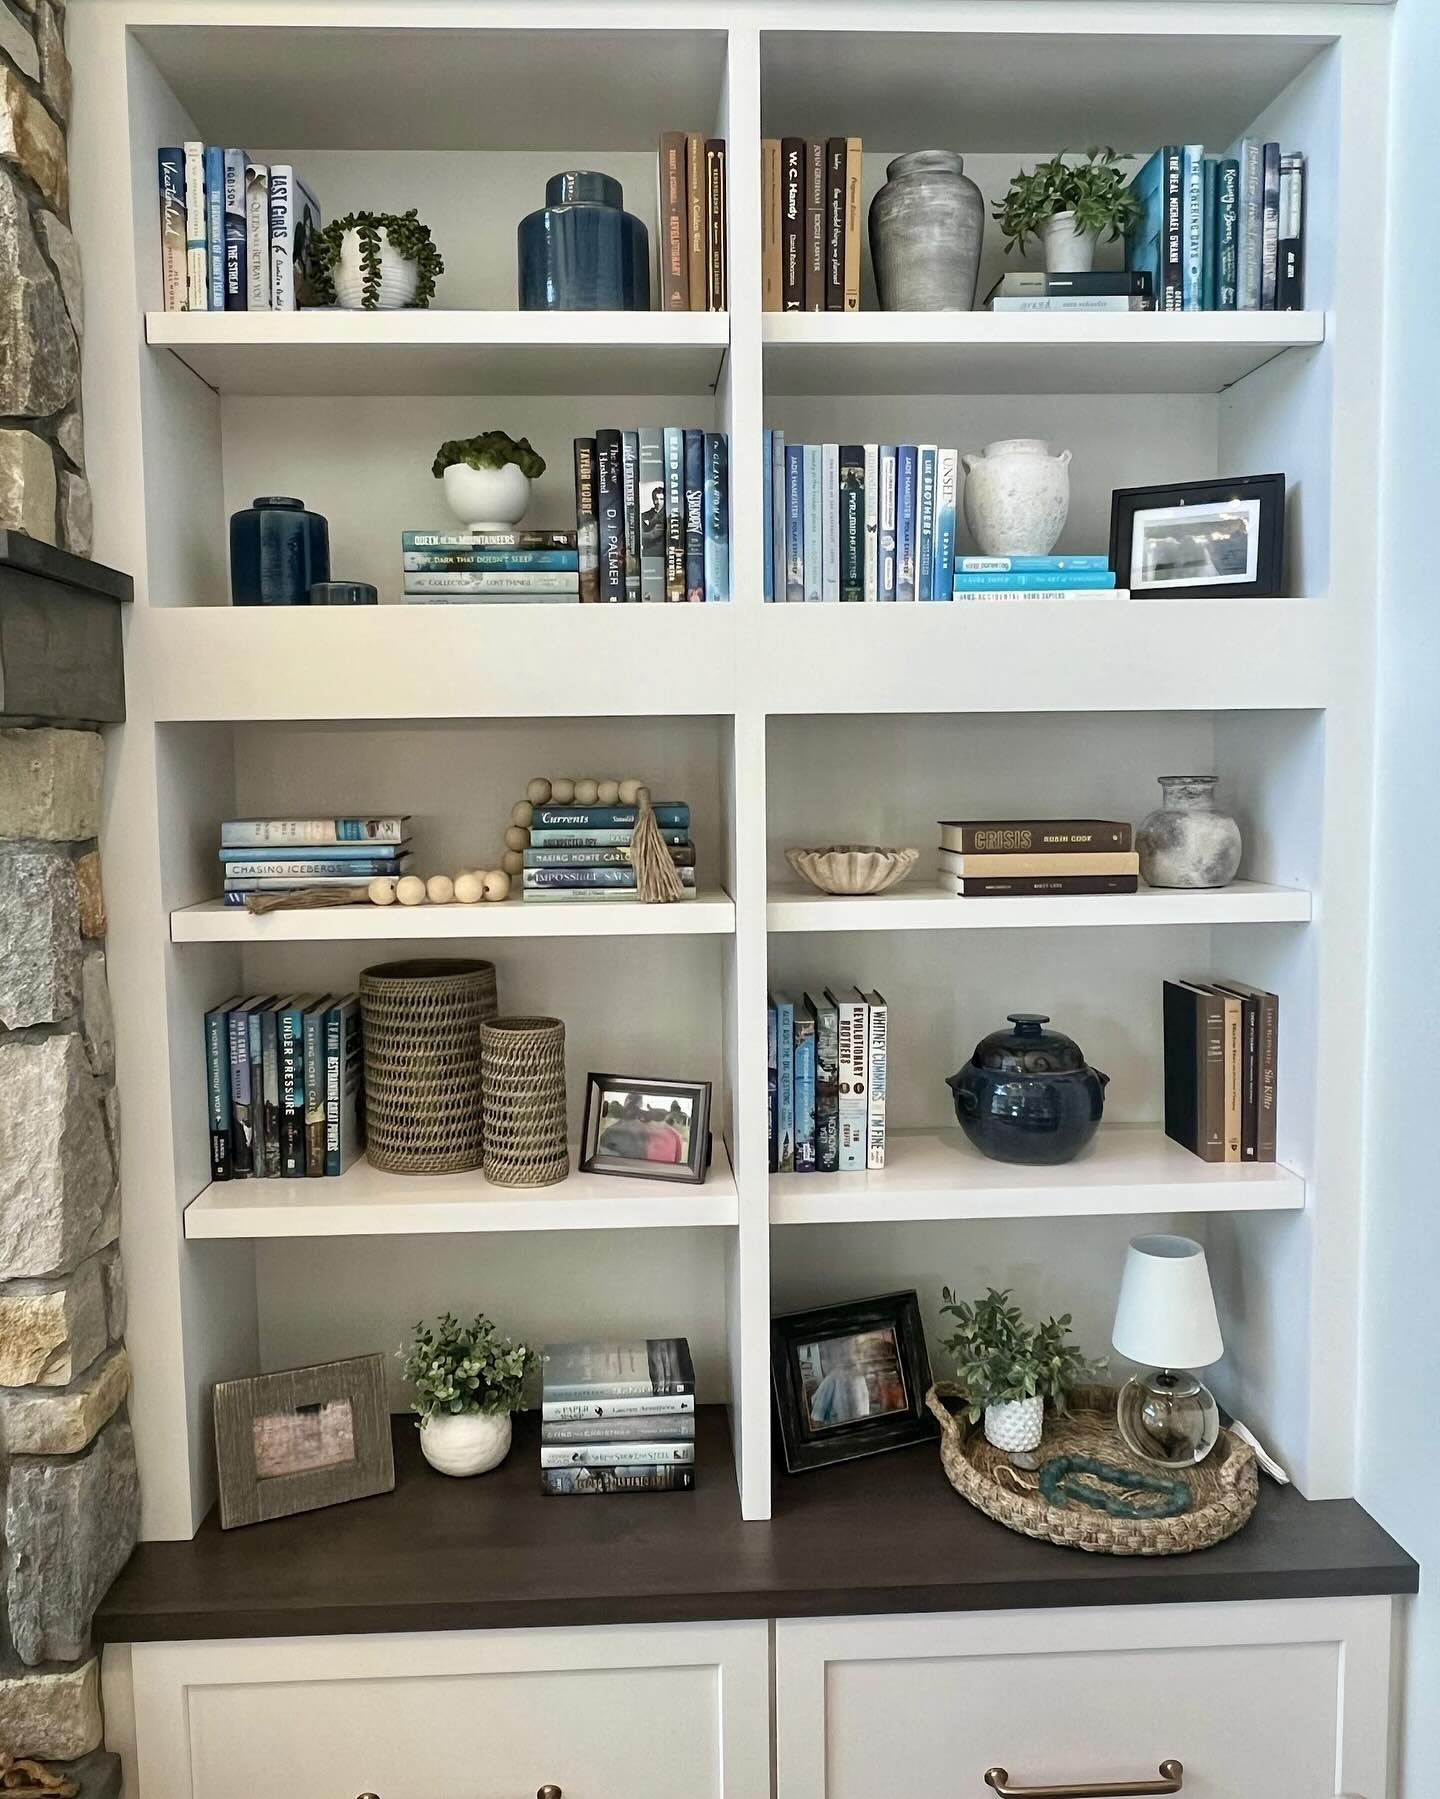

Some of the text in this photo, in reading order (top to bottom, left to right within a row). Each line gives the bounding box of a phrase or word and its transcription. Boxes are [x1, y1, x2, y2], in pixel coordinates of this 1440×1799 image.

[788, 151, 798, 167] W.
[813, 144, 822, 167] JOHN
[1169, 156, 1179, 171] THE
[226, 166, 236, 207] ROBISON
[832, 188, 842, 199] the
[1169, 174, 1179, 194] REAL
[1220, 169, 1236, 204] Raising
[161, 162, 181, 236] Vacationland
[271, 175, 288, 239] LAST GIRLS
[786, 183, 798, 221] Handy
[1190, 182, 1199, 231] LOWERING
[831, 200, 842, 228] splendid
[1169, 197, 1179, 232] MICHAEL
[831, 228, 843, 247] things
[1190, 234, 1199, 258] DAYS
[227, 245, 239, 295] THE STREAM
[831, 259, 842, 285] planned
[579, 448, 592, 515] TAYLOR MOORE
[598, 452, 609, 495] Husband
[670, 436, 679, 540] HARD CASH VALLEY
[606, 509, 617, 521] D.
[923, 477, 932, 536] BROTHERS
[414, 535, 440, 546] QUEEN
[848, 492, 857, 579] PYRAMID HUNTERS
[608, 535, 619, 586] PALMER
[541, 812, 590, 824] Currents
[974, 830, 1033, 850] CRISIS
[1043, 834, 1093, 843] ROBIN COOK
[232, 864, 344, 874] CHASING ICEBERGS
[603, 853, 633, 861] CARLO
[211, 1029, 219, 1056] WORLD
[782, 1029, 791, 1045] ASKS
[840, 1019, 851, 1065] BROTHERS
[852, 1007, 864, 1078] REVOLUTIONARY
[283, 1017, 296, 1117] UNDER PRESSURE
[782, 1047, 791, 1059] THE
[212, 1058, 221, 1094] WITHOUT
[308, 1060, 316, 1088] MONTE
[871, 1010, 887, 1150] WHITNEY CUMMINGS I'M FINE
[1264, 1068, 1274, 1083] Sin
[1263, 1085, 1274, 1110] Killer
[327, 1101, 339, 1123] GREAT
[327, 1123, 339, 1152] POWERS
[819, 1127, 827, 1144] LISA
[828, 1116, 837, 1153] JACKSON
